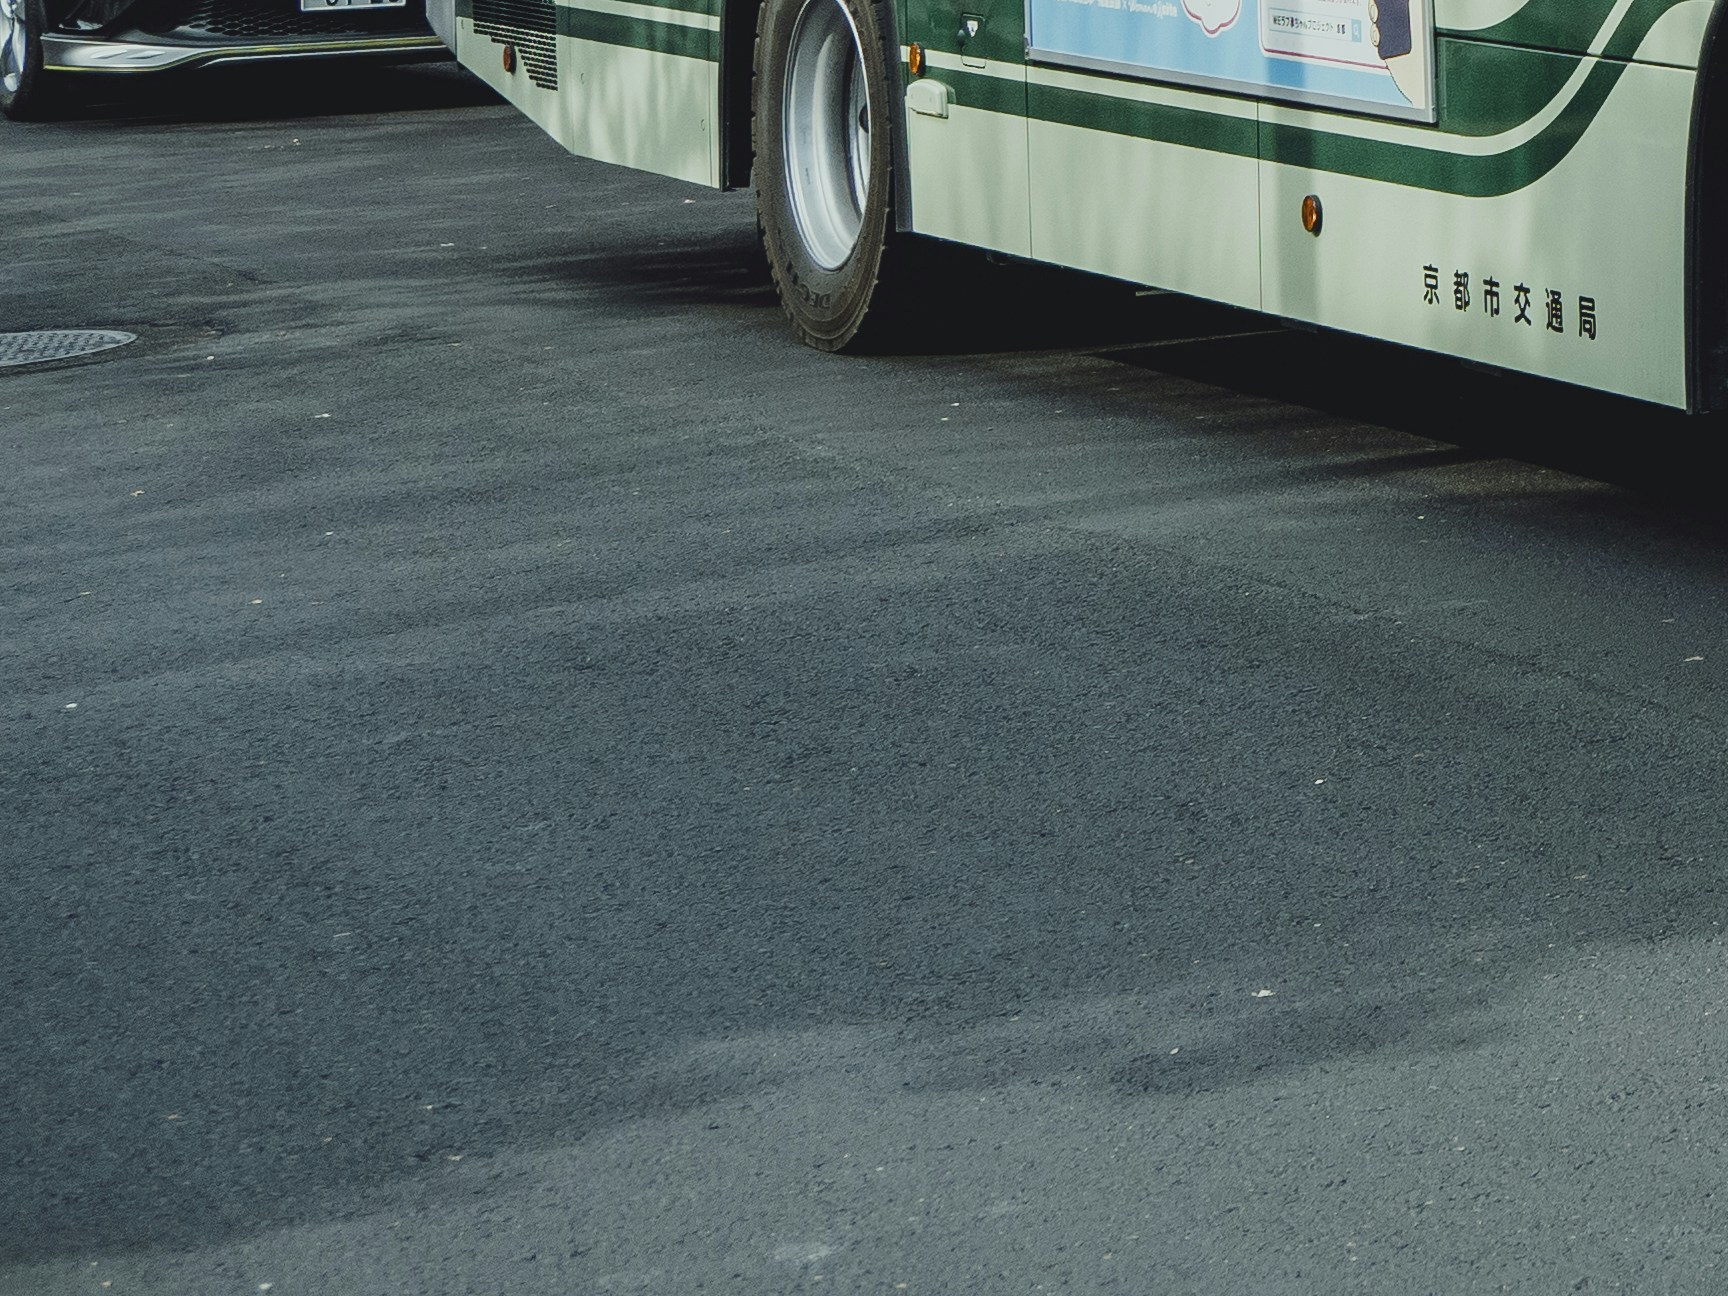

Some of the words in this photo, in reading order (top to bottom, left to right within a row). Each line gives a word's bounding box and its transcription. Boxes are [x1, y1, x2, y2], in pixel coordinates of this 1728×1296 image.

[1422, 263, 1597, 340] 京都市交通局
